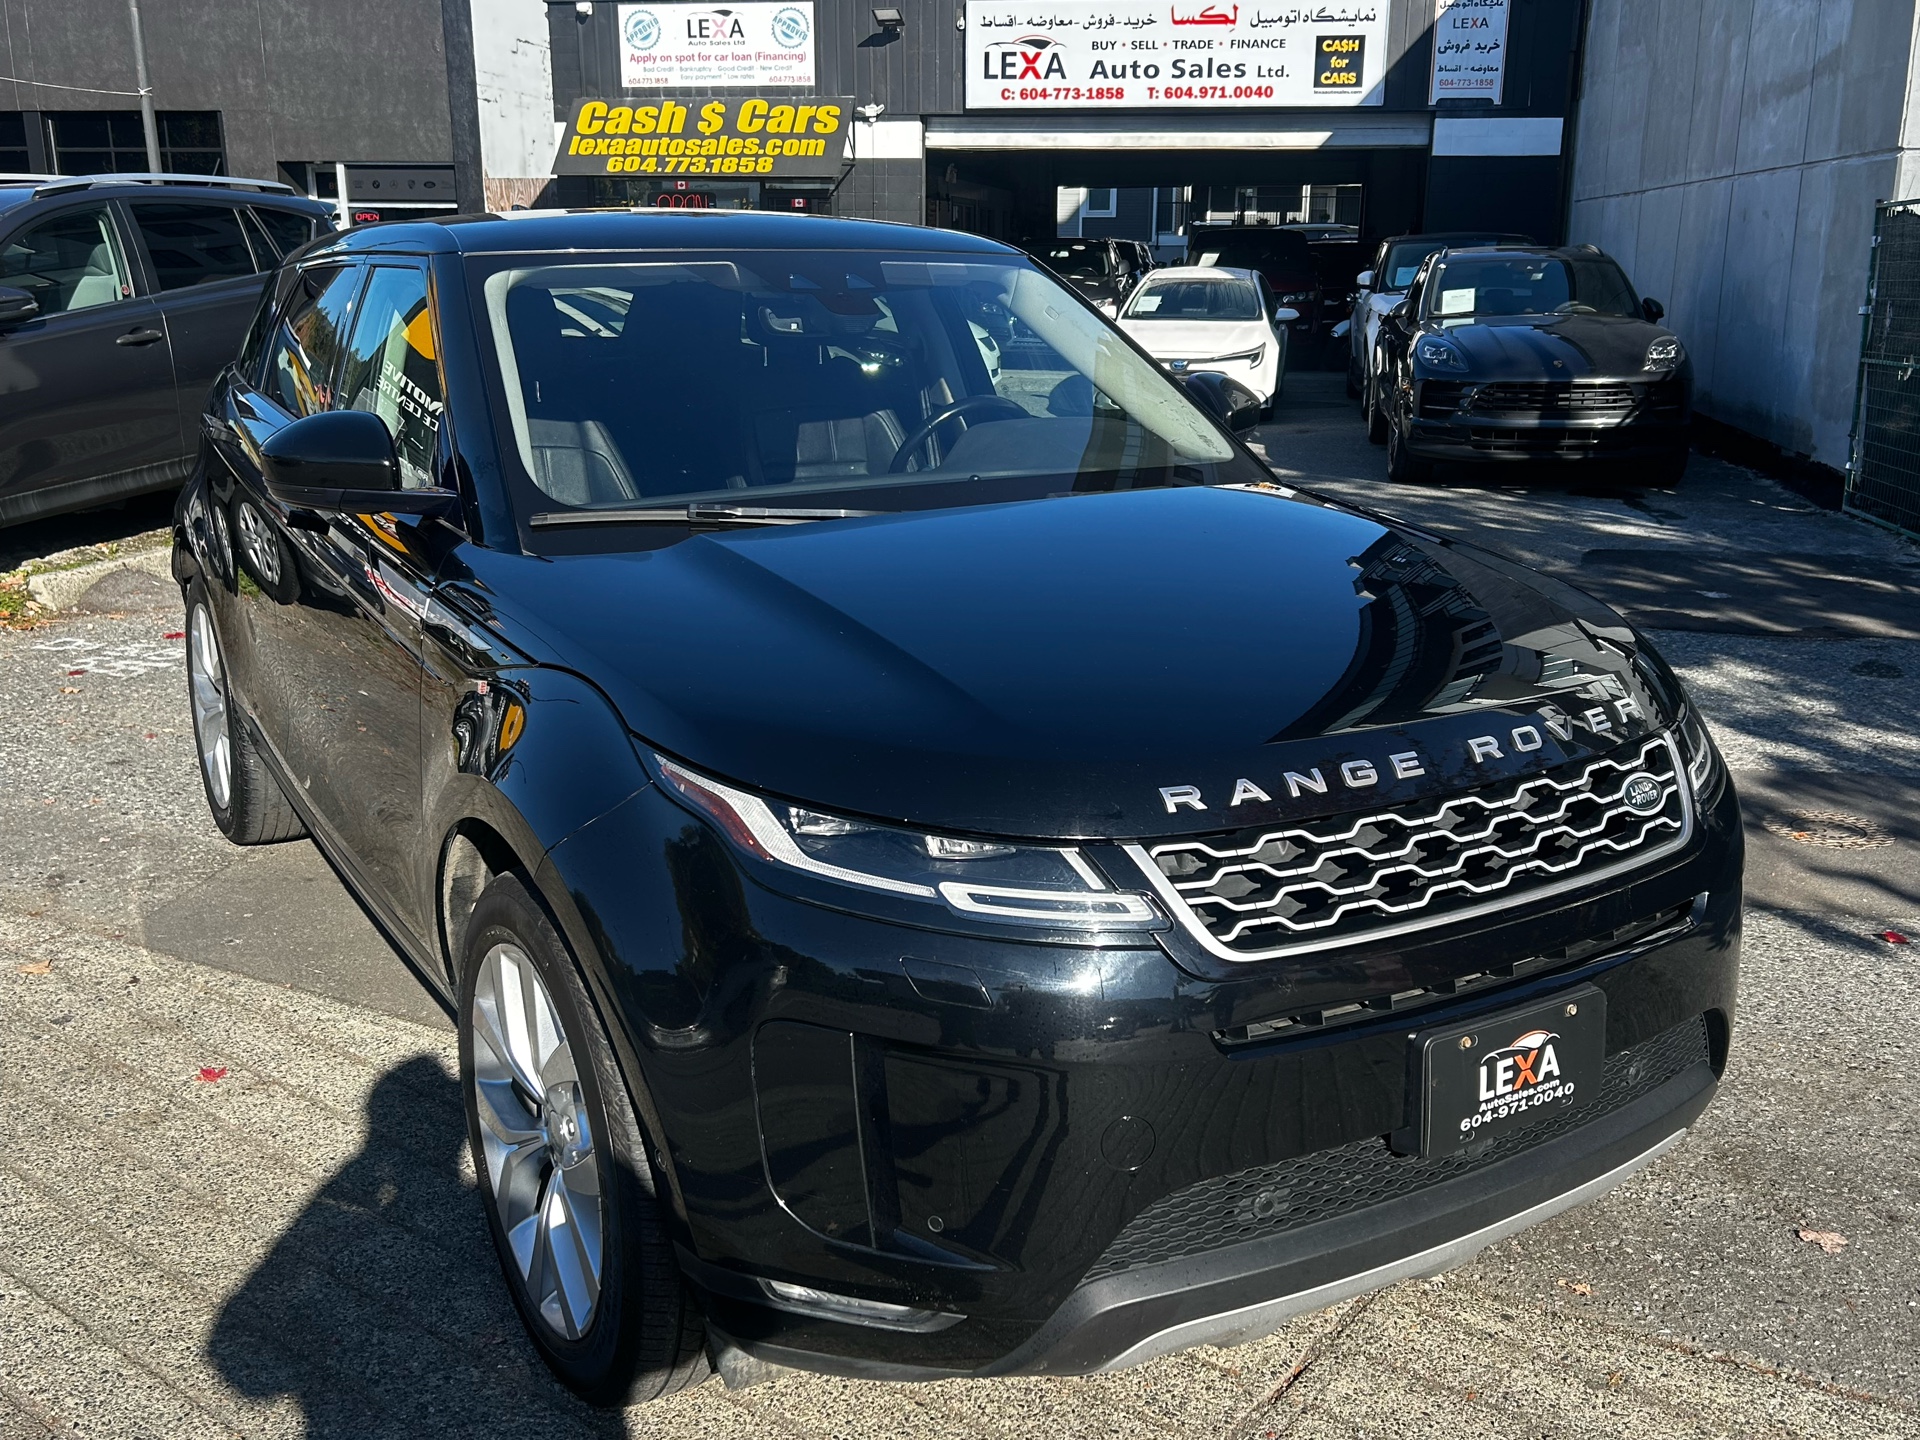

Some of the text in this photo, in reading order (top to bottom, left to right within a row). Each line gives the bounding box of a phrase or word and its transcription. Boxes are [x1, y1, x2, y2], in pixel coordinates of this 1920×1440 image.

[1250, 9, 1301, 28] اتومبیل
[1303, 7, 1376, 27] نمایشگاه
[1453, 18, 1489, 29] LEXA
[627, 17, 659, 43] APPROVED
[687, 18, 745, 39] LEXA
[773, 15, 808, 42] APPROVED
[1091, 38, 1287, 51] BUY SELL TRADE FINANCE
[1437, 39, 1501, 55] خرید فروش
[630, 53, 657, 65] Apply
[675, 53, 695, 64] spot
[698, 52, 712, 62] for
[714, 54, 729, 62] car
[732, 52, 752, 61] loan
[755, 51, 807, 63] (Financing)
[983, 51, 1067, 80] LEXA
[1330, 56, 1349, 68] for
[1089, 57, 1290, 80] Auto Sales Ltd.
[1320, 71, 1357, 84] CARS
[1147, 86, 1274, 99] T: 604.971.0040
[1439, 79, 1494, 87] 604-773-1858
[1001, 87, 1125, 100] C: 604-773-1858
[576, 98, 842, 135] Cash $ Cars
[568, 135, 827, 156] lexaautosales.com
[606, 157, 775, 174] 604.773.1858
[1158, 697, 1644, 814] RANGE ROVER
[1629, 782, 1651, 797] LAND
[1635, 789, 1658, 806] ROVER
[1479, 1043, 1561, 1102] LEXA
[1478, 1078, 1560, 1113] AutoSales.com
[1460, 1082, 1575, 1132] 604-971-0040
